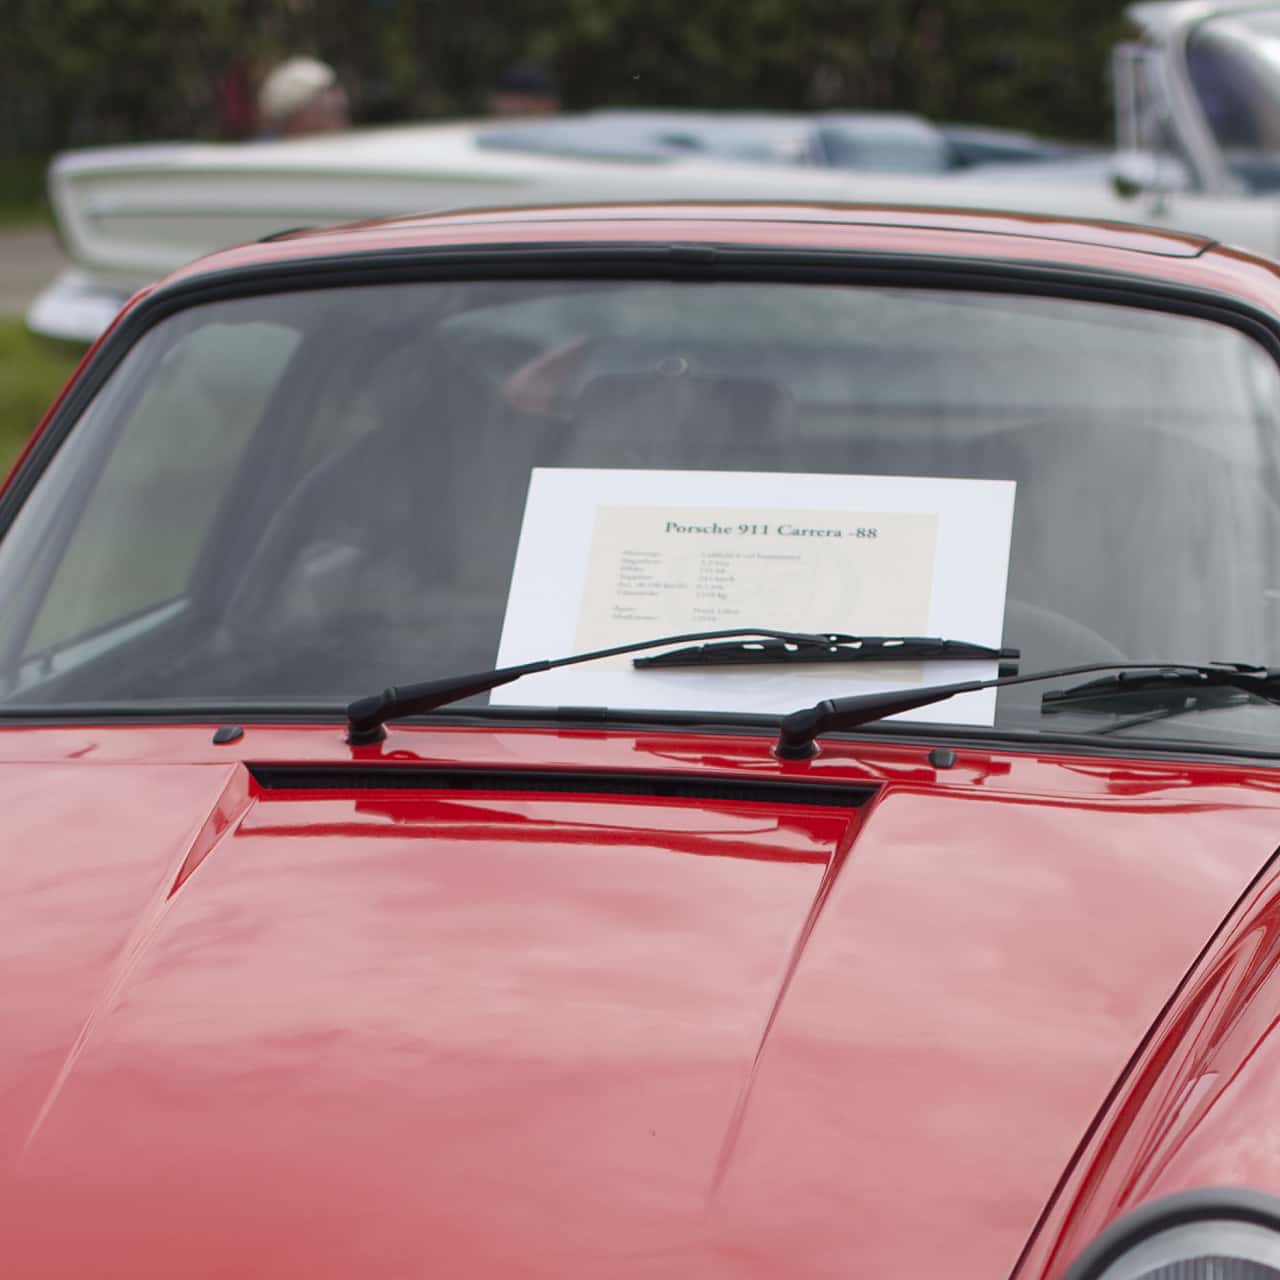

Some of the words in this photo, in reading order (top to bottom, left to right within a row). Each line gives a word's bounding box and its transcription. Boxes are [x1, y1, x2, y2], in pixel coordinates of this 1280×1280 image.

[664, 521, 733, 535] Porsche
[737, 523, 769, 536] 911
[777, 524, 842, 538] Carrera
[848, 527, 879, 539] -88
